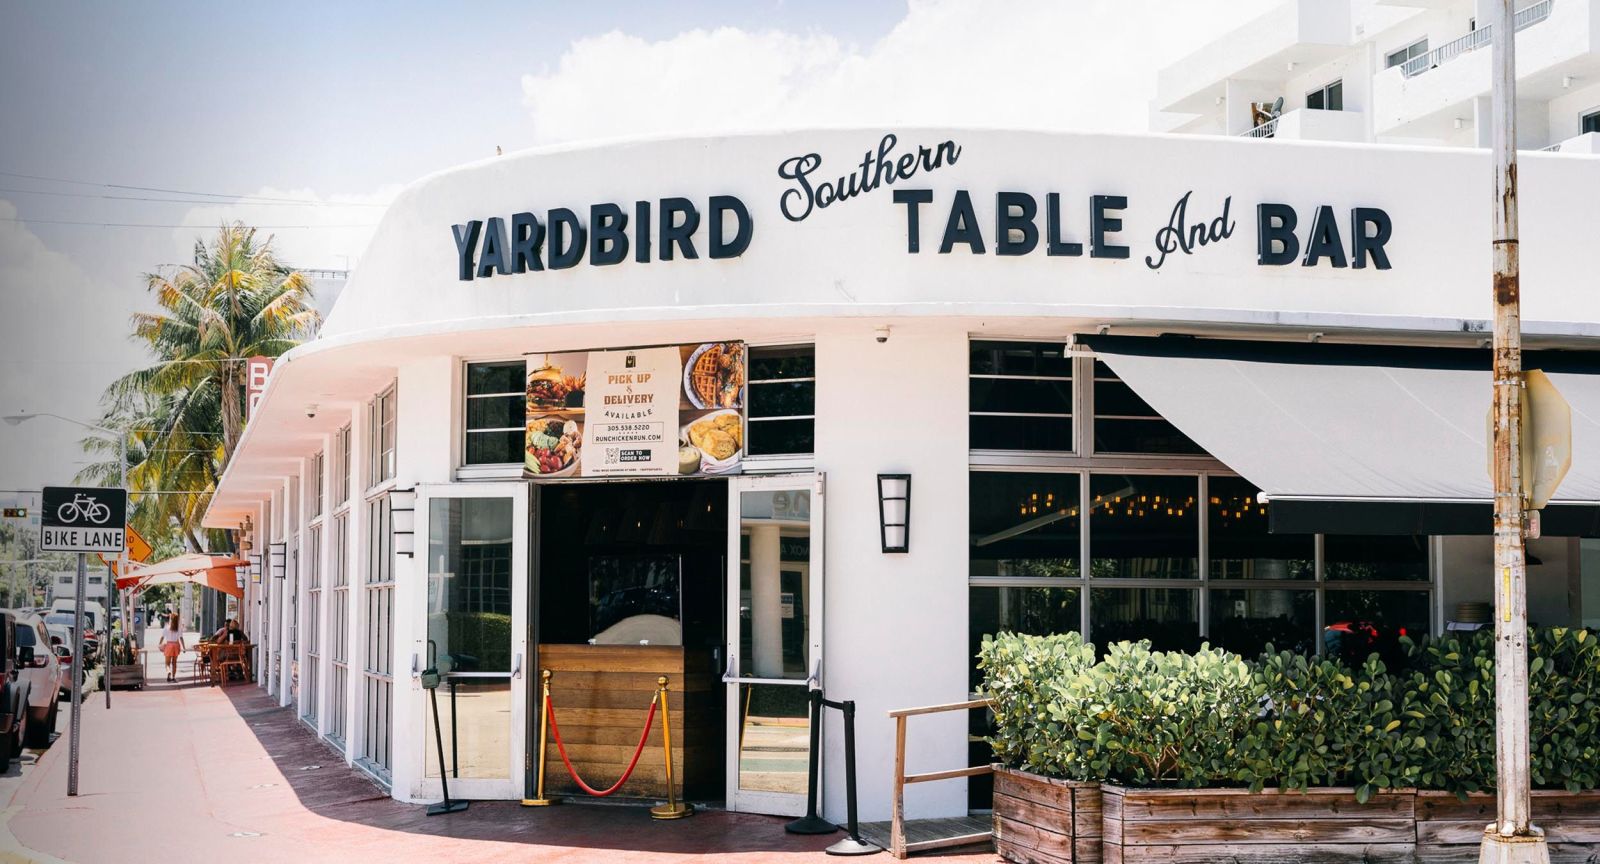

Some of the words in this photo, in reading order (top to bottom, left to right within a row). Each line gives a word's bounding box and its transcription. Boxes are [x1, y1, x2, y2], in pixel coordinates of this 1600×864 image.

[778, 133, 962, 222] Southern
[451, 195, 754, 282] YARDBIRD
[893, 189, 1130, 259] TABLE
[1145, 190, 1236, 270] And
[1257, 202, 1393, 270] BAR
[604, 394, 654, 405] DELIVERY
[608, 374, 633, 384] PICK
[637, 373, 651, 383] UP
[605, 409, 653, 419] AVAILABLE
[595, 434, 661, 442] RUNCHICKENRUN.COM
[44, 530, 78, 546] BIKE
[84, 531, 122, 547] LANE
